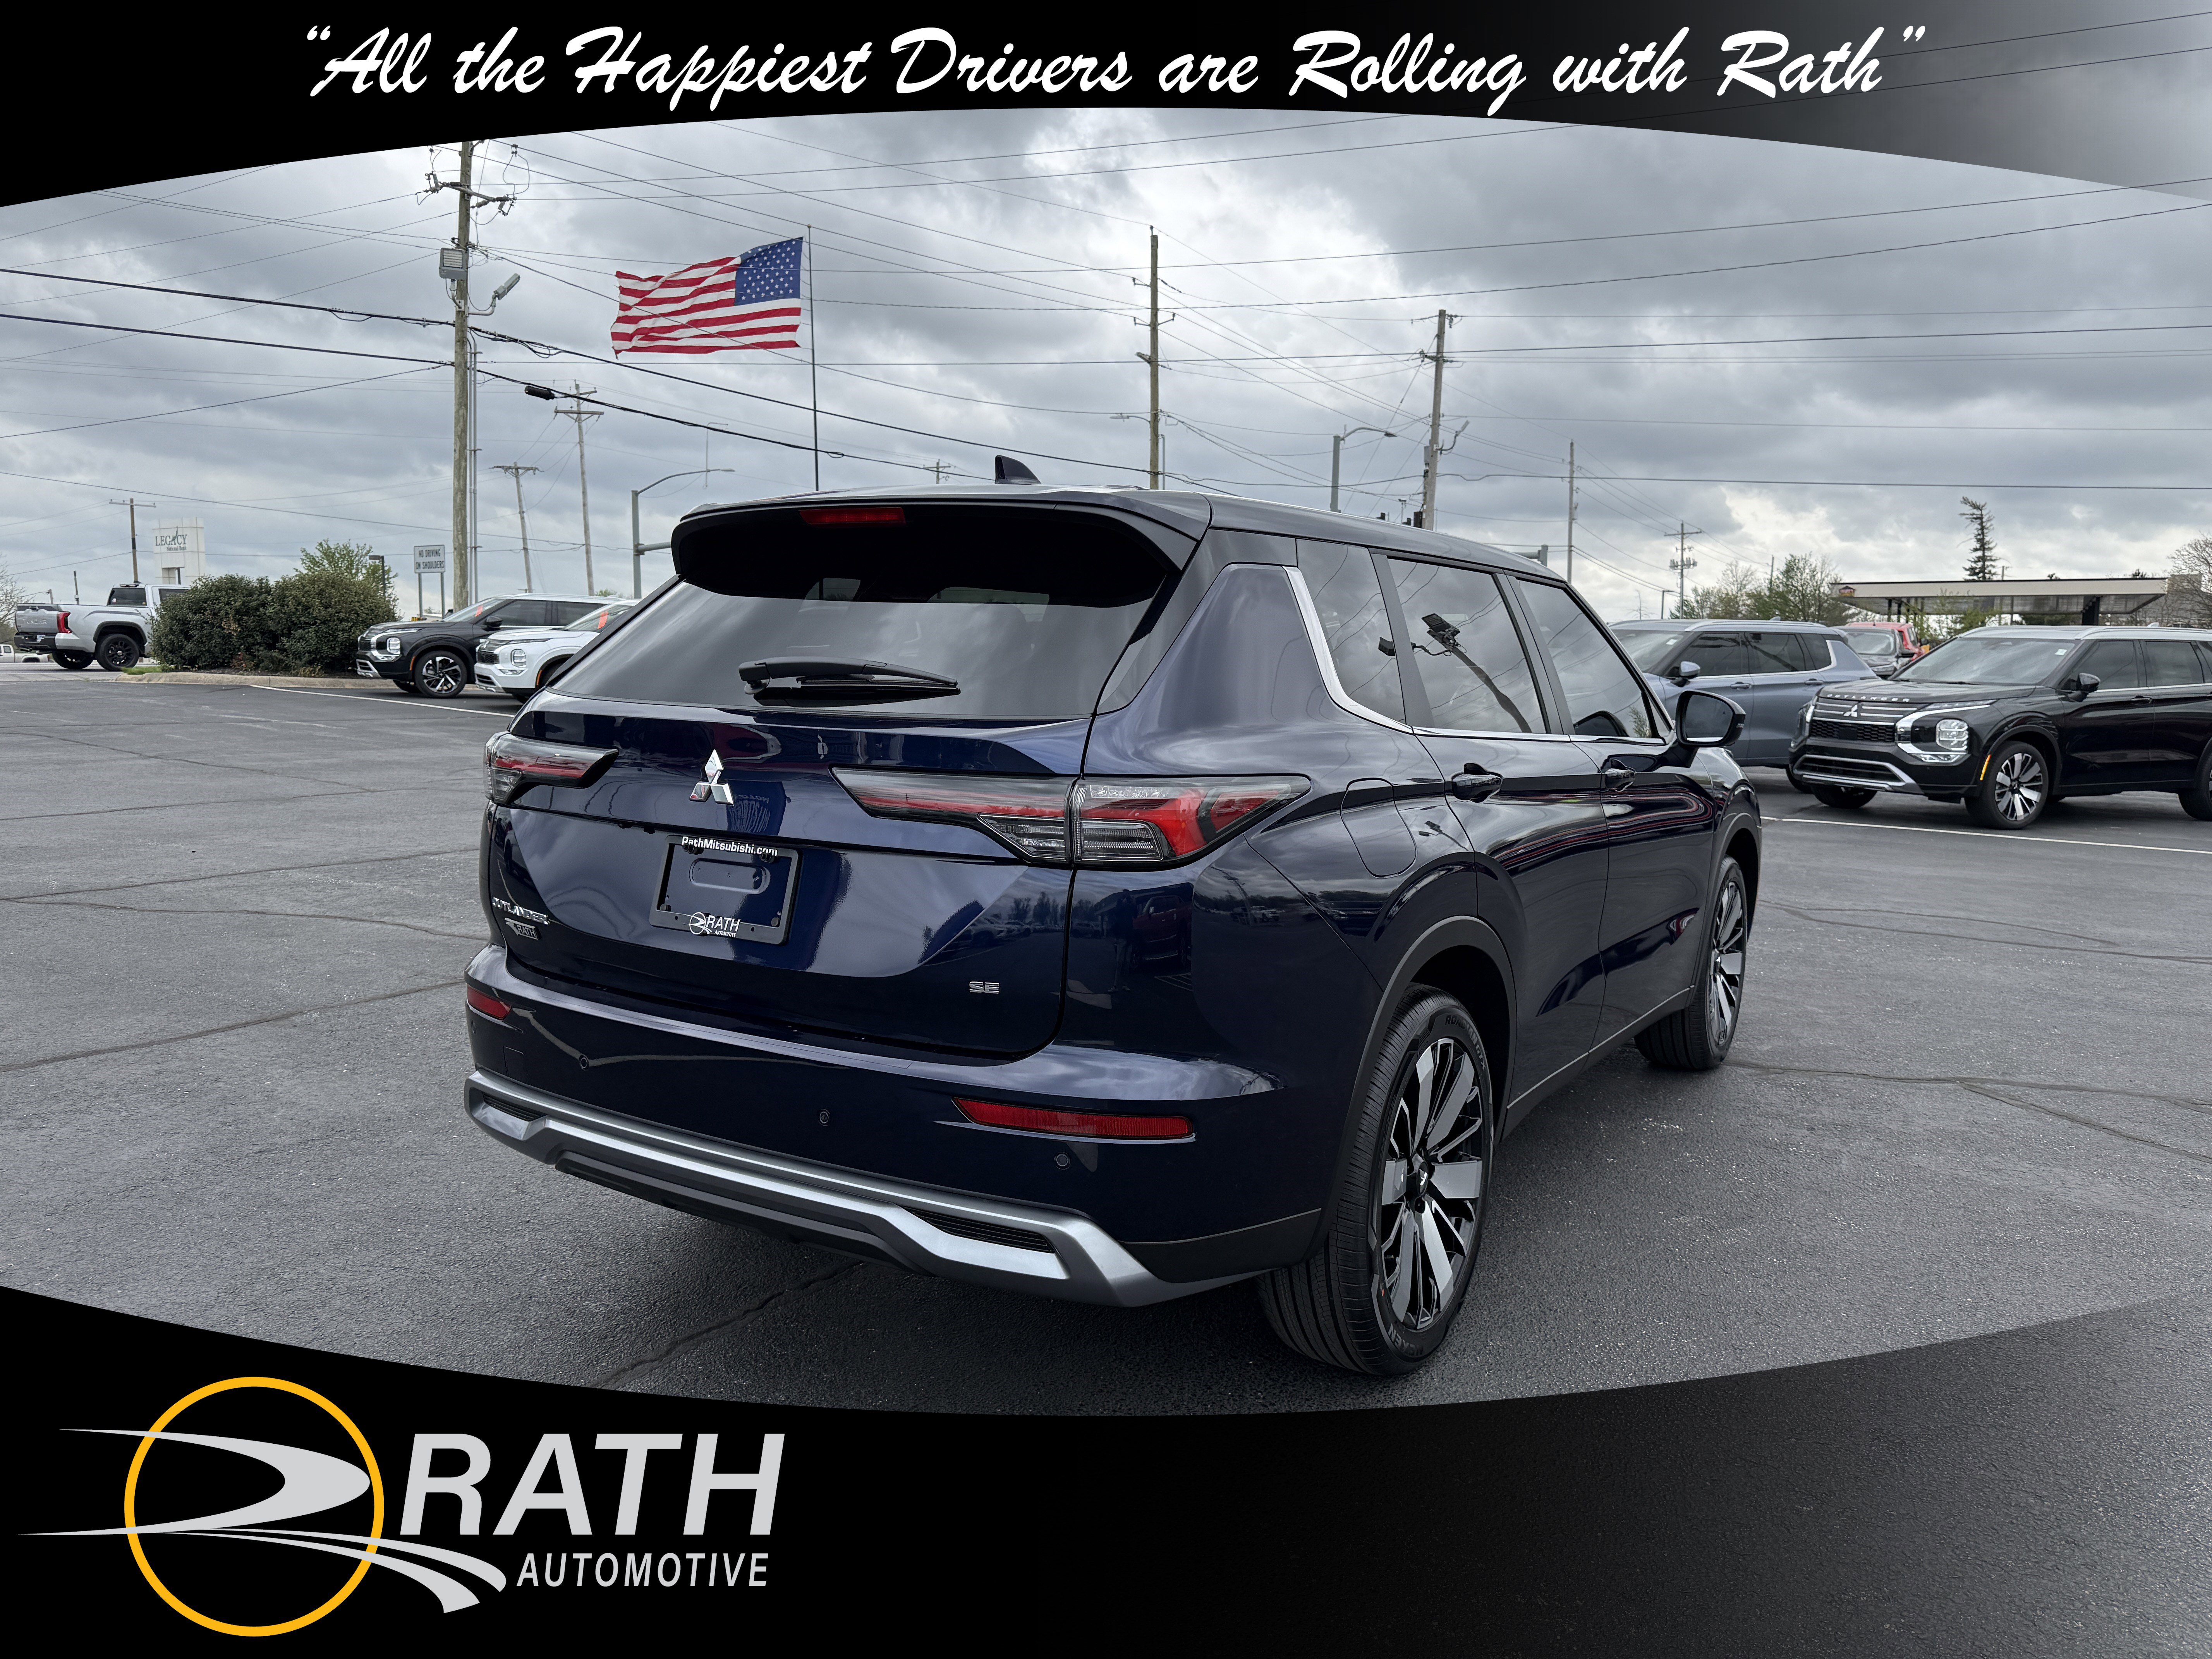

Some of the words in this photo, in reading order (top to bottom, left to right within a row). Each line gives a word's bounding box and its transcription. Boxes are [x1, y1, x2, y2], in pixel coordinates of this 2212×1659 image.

[155, 532, 187, 546] LEGACY
[425, 549, 441, 557] DRIVING
[422, 561, 444, 569] SHOULDERS
[1827, 694, 1910, 702] OUTLANDER
[706, 915, 740, 932] RATH
[516, 925, 536, 938] RATH
[969, 981, 999, 994] SE
